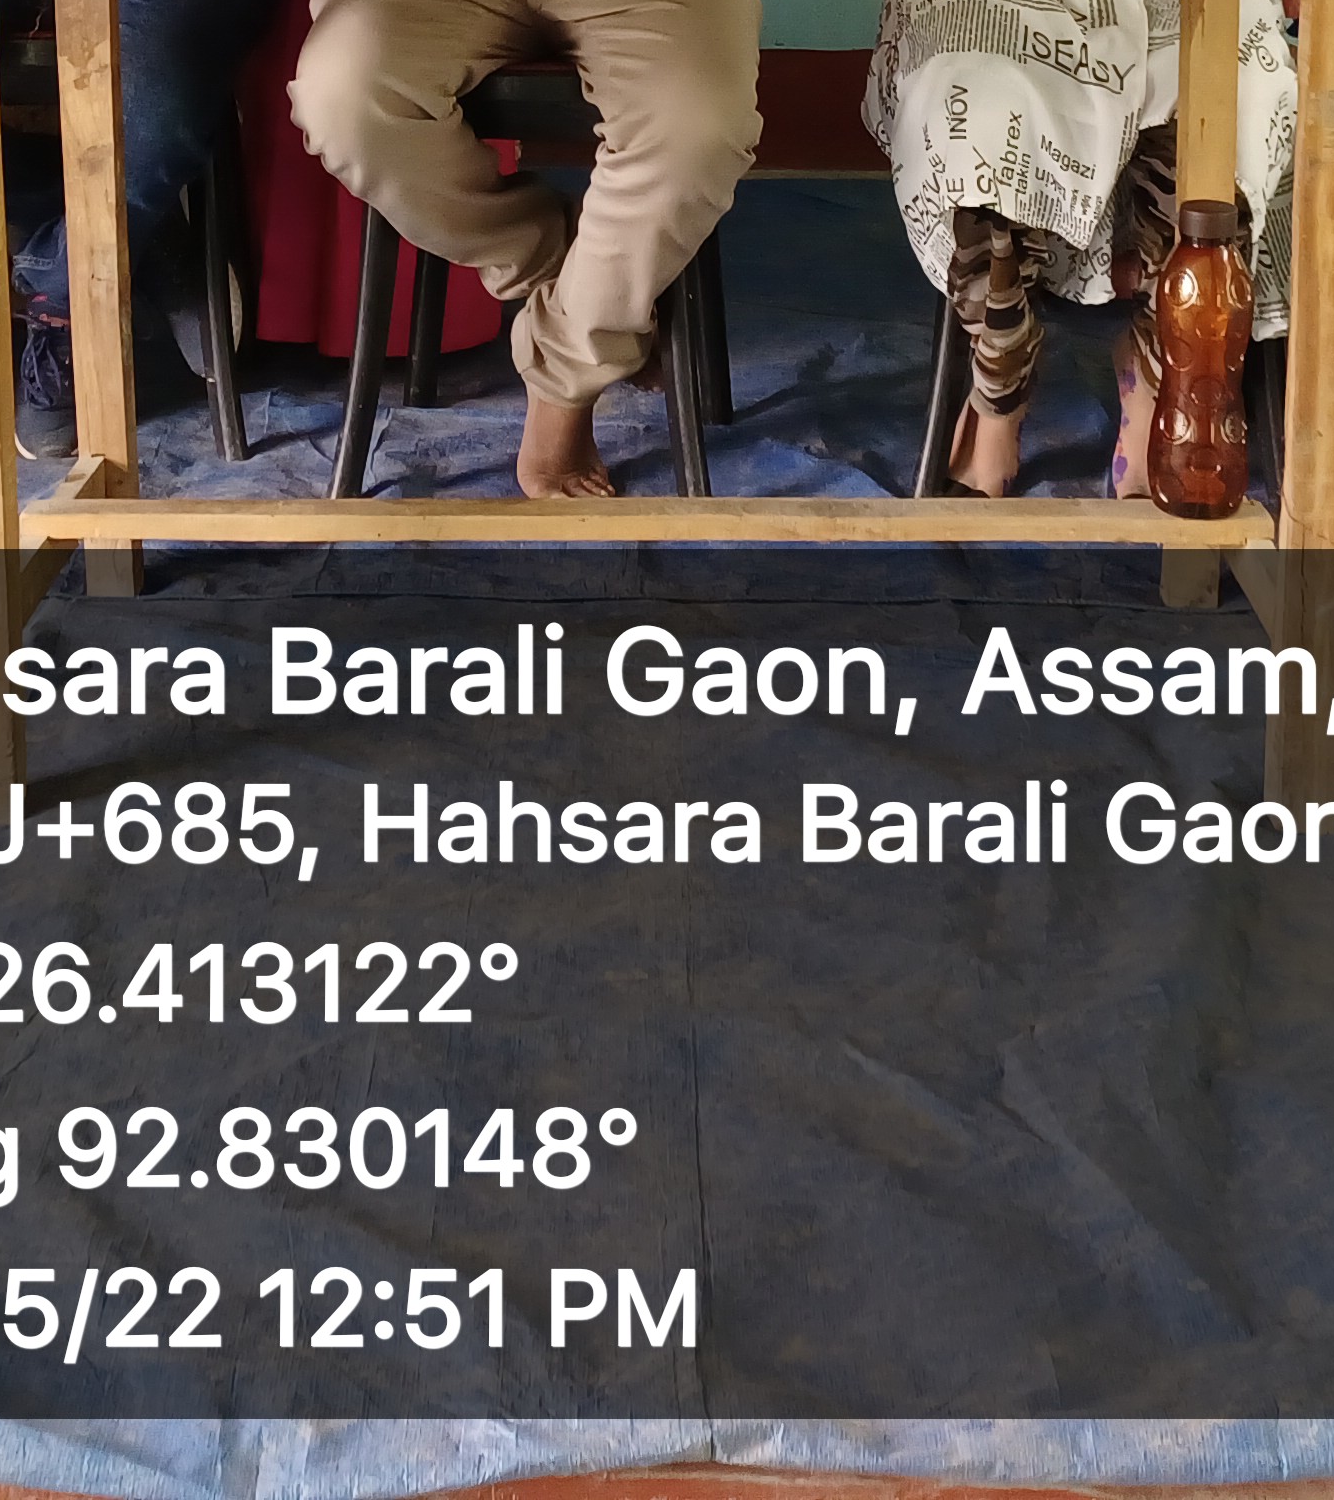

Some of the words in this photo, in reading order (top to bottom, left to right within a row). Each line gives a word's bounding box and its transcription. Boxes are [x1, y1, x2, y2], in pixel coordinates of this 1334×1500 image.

[1022, 25, 1136, 91] ISEASY
[997, 111, 1023, 188] fabrex
[1040, 134, 1097, 181] Magazi
